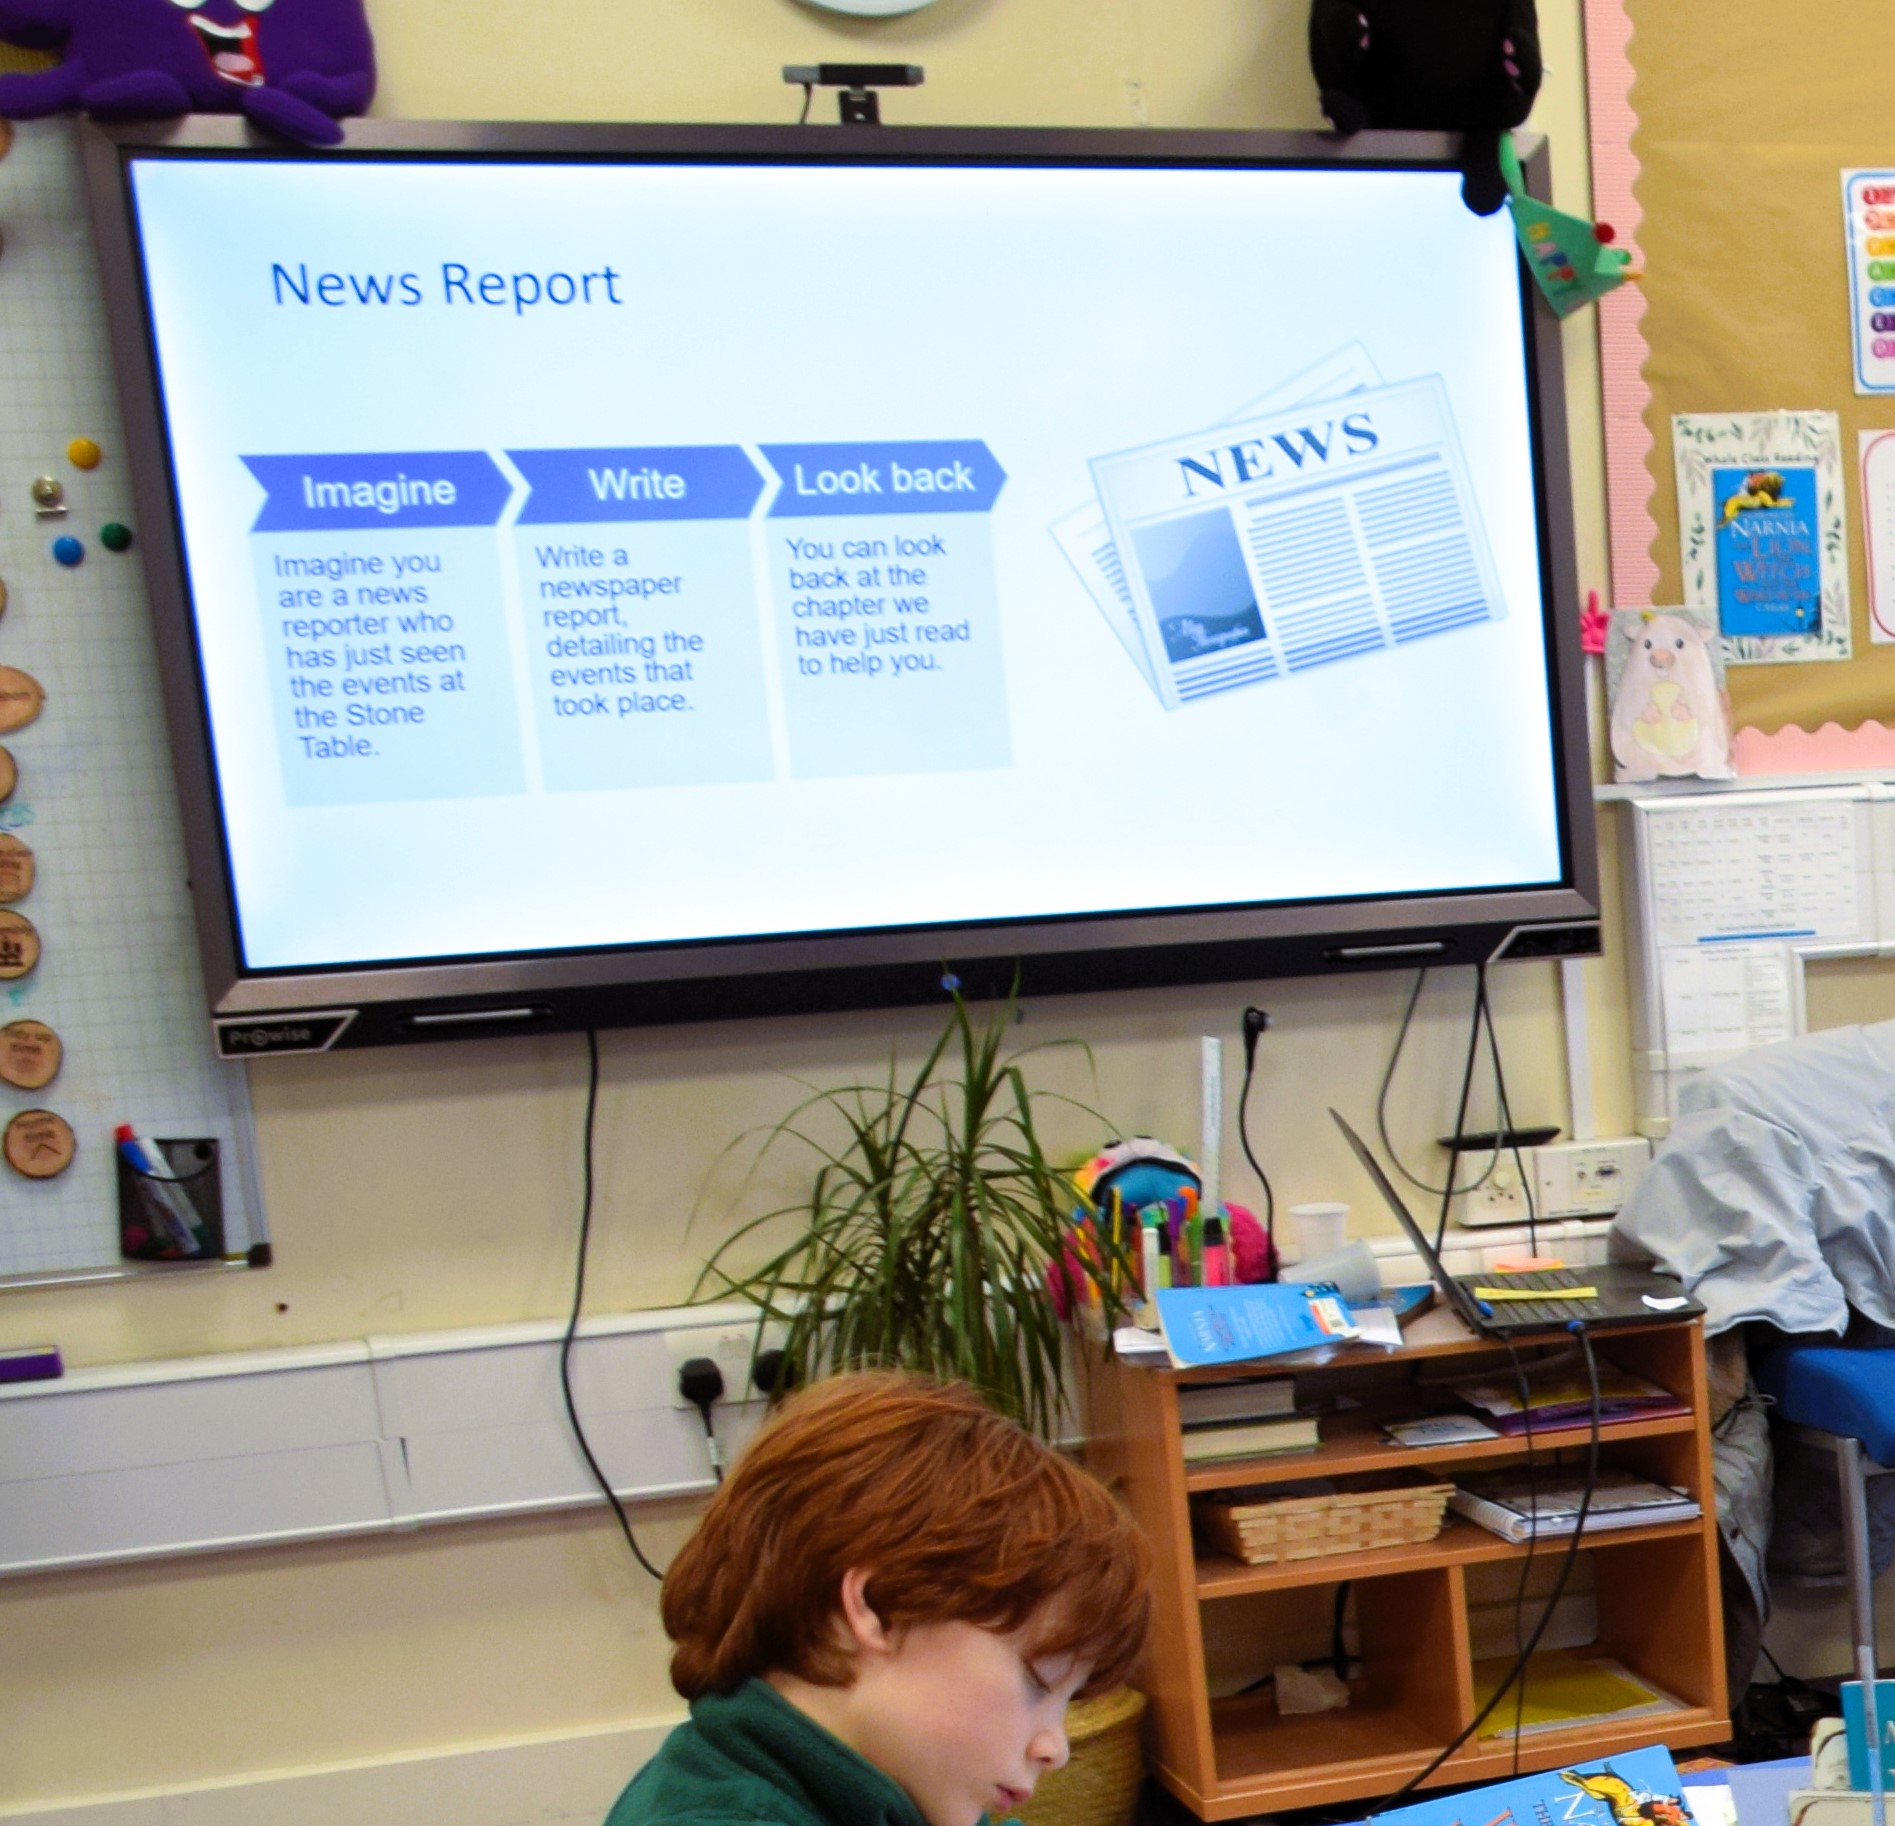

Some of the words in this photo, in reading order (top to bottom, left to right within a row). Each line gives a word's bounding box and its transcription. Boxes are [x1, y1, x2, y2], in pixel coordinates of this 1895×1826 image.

[271, 262, 422, 307] News
[441, 262, 624, 316] Report
[1174, 411, 1380, 498] NEWS
[589, 468, 686, 502] Write
[794, 462, 882, 495] Look
[891, 460, 977, 493] back
[303, 473, 457, 514] Imagine
[1730, 518, 1810, 537] NARNIA
[535, 543, 604, 569] Write
[613, 546, 630, 567] a
[785, 537, 834, 560] You
[842, 540, 888, 559] can
[894, 534, 948, 557] look
[274, 552, 384, 582] Imagine
[393, 553, 442, 580] you
[789, 567, 850, 590] back
[856, 566, 881, 587] at
[887, 565, 927, 587] the
[278, 587, 323, 609] are
[333, 587, 349, 607] a
[357, 584, 429, 606] news
[540, 575, 683, 602] newspaper
[543, 604, 629, 630] report,
[792, 596, 885, 620] chapter
[892, 595, 930, 613] we
[282, 614, 390, 642] reporter
[398, 610, 455, 633] who
[794, 625, 856, 647] have
[863, 622, 908, 649] just
[915, 619, 971, 642] read
[286, 645, 337, 670] has
[344, 641, 393, 671] just
[401, 642, 467, 665] seen
[547, 634, 656, 660] detailing
[663, 629, 704, 654] the
[551, 665, 637, 688] events
[643, 659, 695, 683] that
[797, 655, 822, 676] to
[830, 652, 883, 677] help
[890, 652, 943, 676] you.
[290, 674, 334, 699] the
[342, 672, 431, 697] events
[438, 669, 466, 693] at
[294, 706, 338, 730] the
[346, 703, 426, 727] Stone
[553, 693, 612, 718] took
[616, 690, 695, 718] place.
[299, 734, 381, 761] Table.
